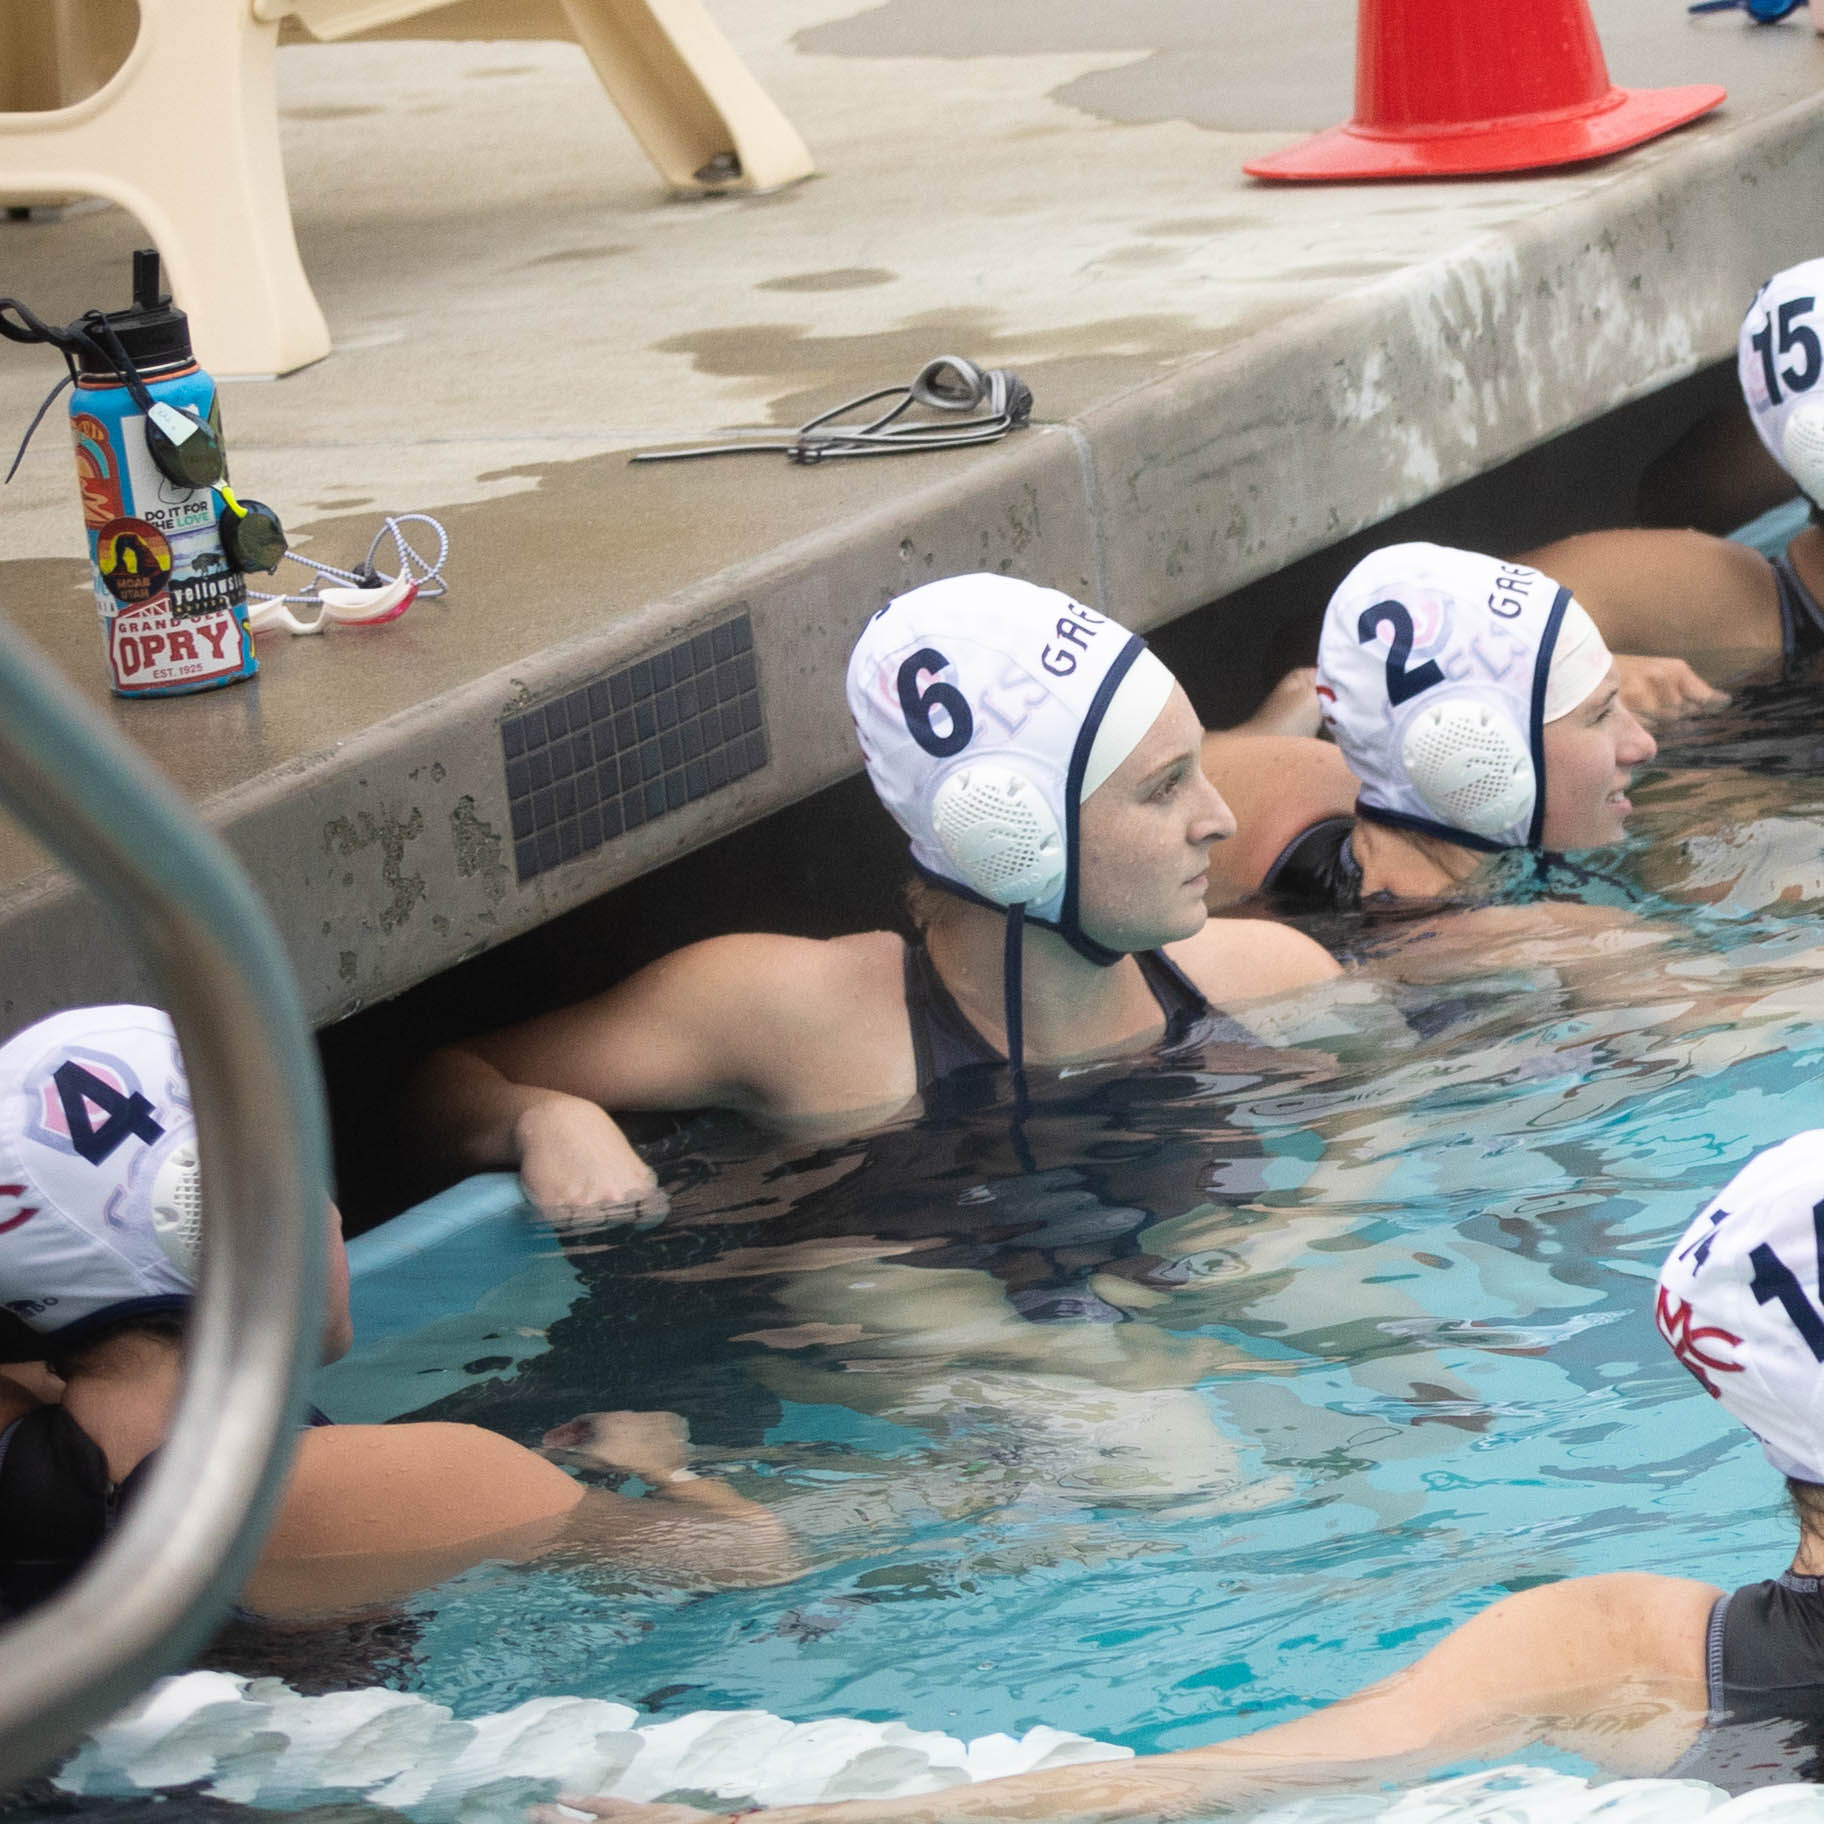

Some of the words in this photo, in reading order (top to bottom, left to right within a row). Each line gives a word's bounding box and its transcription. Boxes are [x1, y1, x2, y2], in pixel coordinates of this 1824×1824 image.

[1752, 296, 1823, 407] 15
[145, 509, 165, 522] DO
[168, 506, 181, 518] IT
[183, 501, 208, 515] FOR
[176, 512, 209, 527] LOVE
[119, 621, 228, 677] OPRY
[897, 647, 973, 758] 6
[1358, 600, 1445, 707] 2
[53, 1060, 166, 1167] 4
